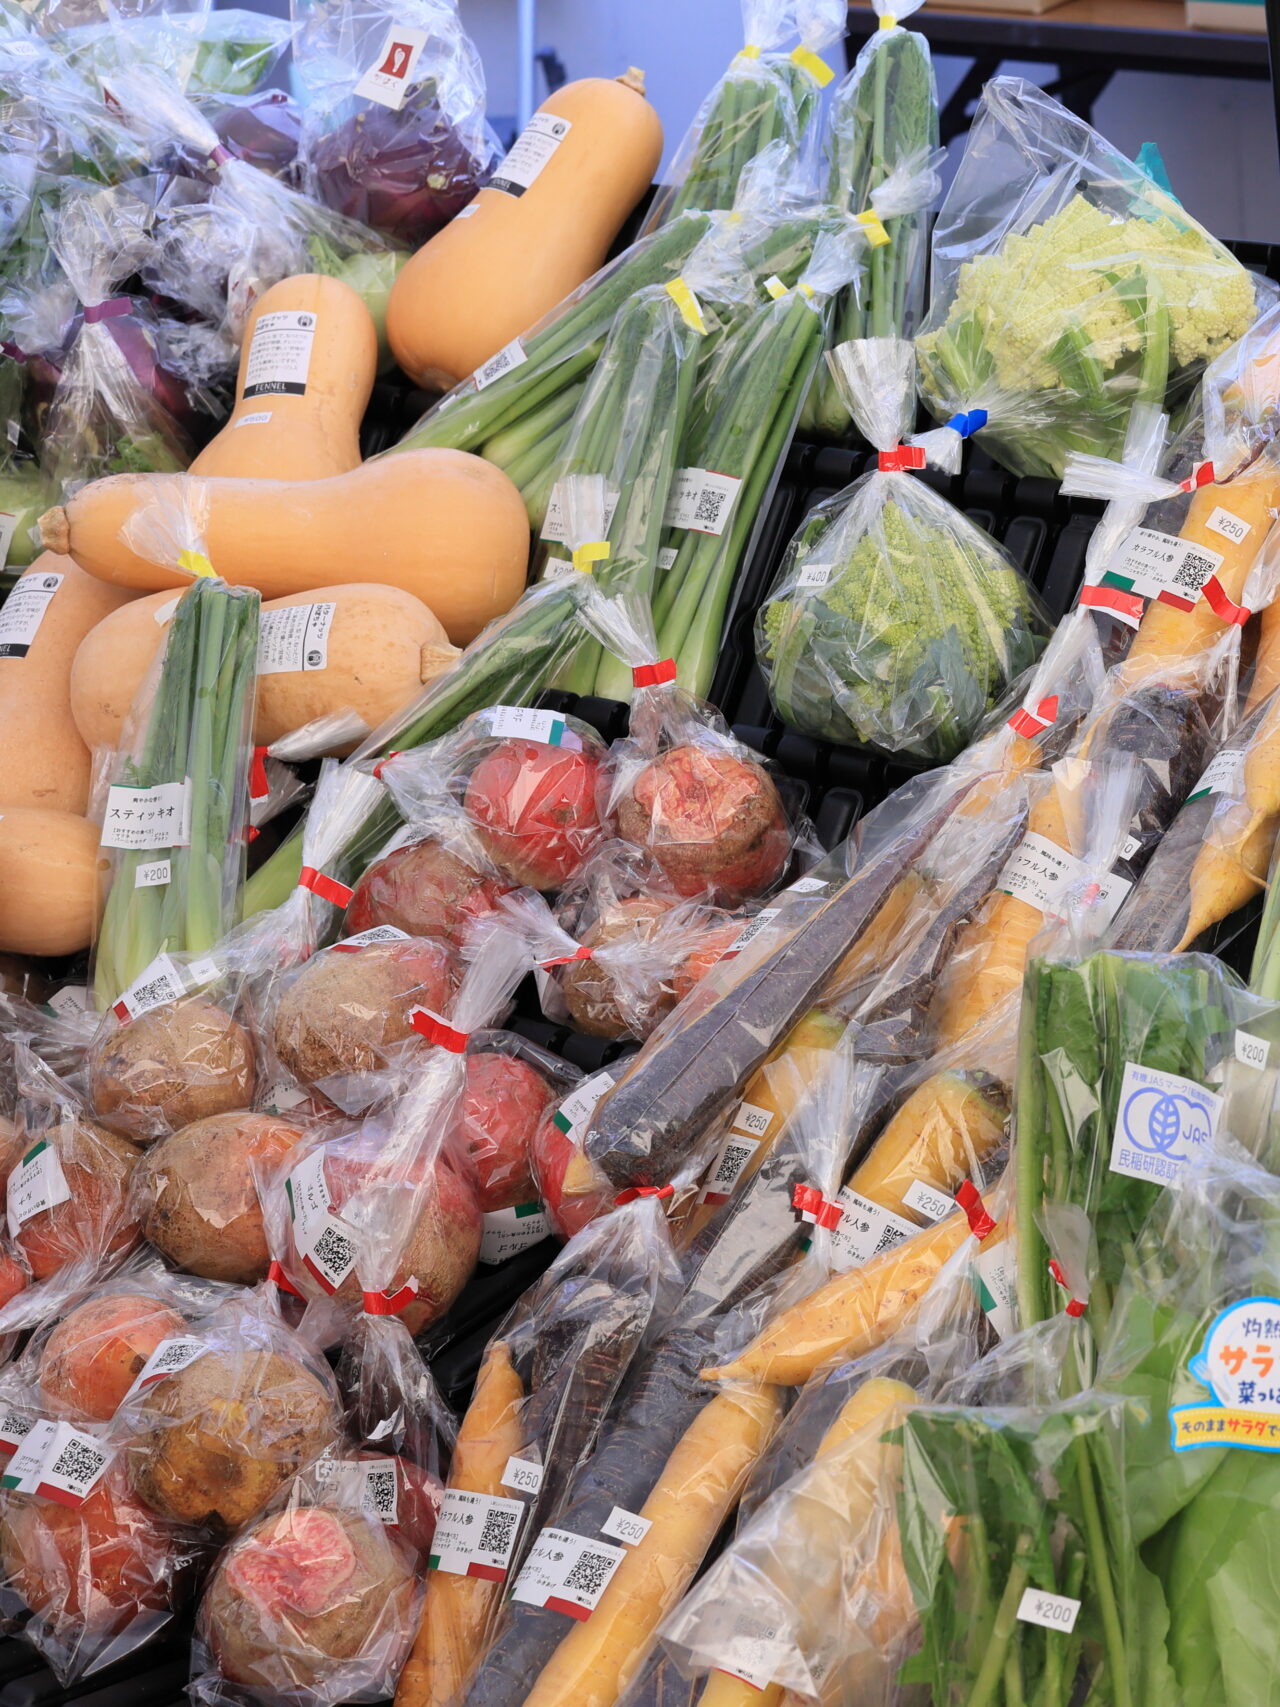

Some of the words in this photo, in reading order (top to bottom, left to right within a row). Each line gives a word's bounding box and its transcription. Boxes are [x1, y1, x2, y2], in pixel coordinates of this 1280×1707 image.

[255, 382, 287, 392] FENNEL
[1218, 516, 1244, 538] ¥250
[1132, 543, 1175, 562] カラフル人参
[110, 805, 175, 821] スティッキオ
[144, 867, 168, 881] ¥200
[1241, 1041, 1265, 1063] ¥200
[745, 1112, 768, 1131] ¥250
[1183, 1124, 1208, 1144] JAS
[917, 1193, 946, 1216] ¥250
[497, 1242, 528, 1253] ゴルゴ
[513, 1468, 539, 1489] ¥250
[615, 1518, 644, 1540] ¥250
[1035, 1599, 1072, 1623] ¥200
